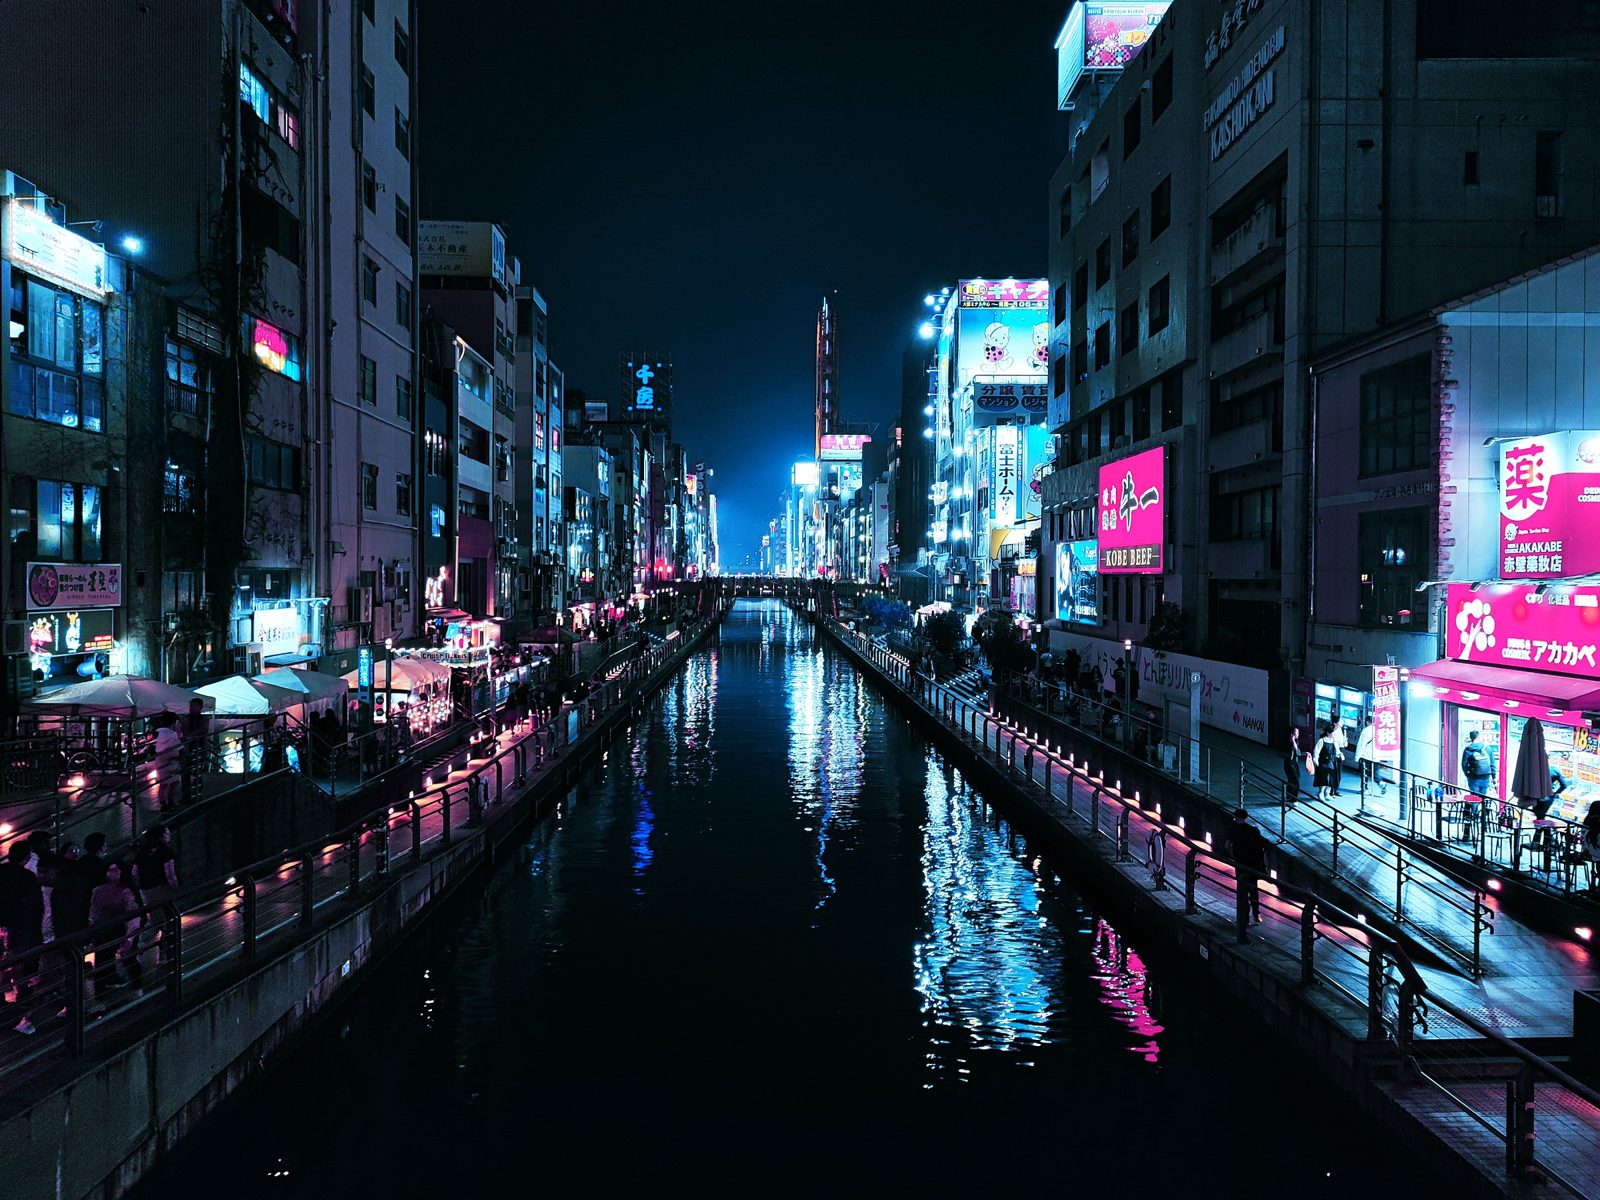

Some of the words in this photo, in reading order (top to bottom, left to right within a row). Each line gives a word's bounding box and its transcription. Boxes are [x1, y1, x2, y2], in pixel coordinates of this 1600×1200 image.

[981, 397, 1017, 406] マンション
[1505, 444, 1545, 511] 薬
[1105, 549, 1128, 566] KOBE
[1130, 547, 1153, 565] BEEF
[1520, 542, 1562, 553] AKAKABE
[422, 652, 444, 660] Cruise
[1533, 641, 1596, 667] アカカベ
[1377, 683, 1395, 698] TAX
[1243, 716, 1265, 734] NANKAI
[1378, 711, 1397, 747] 免税
